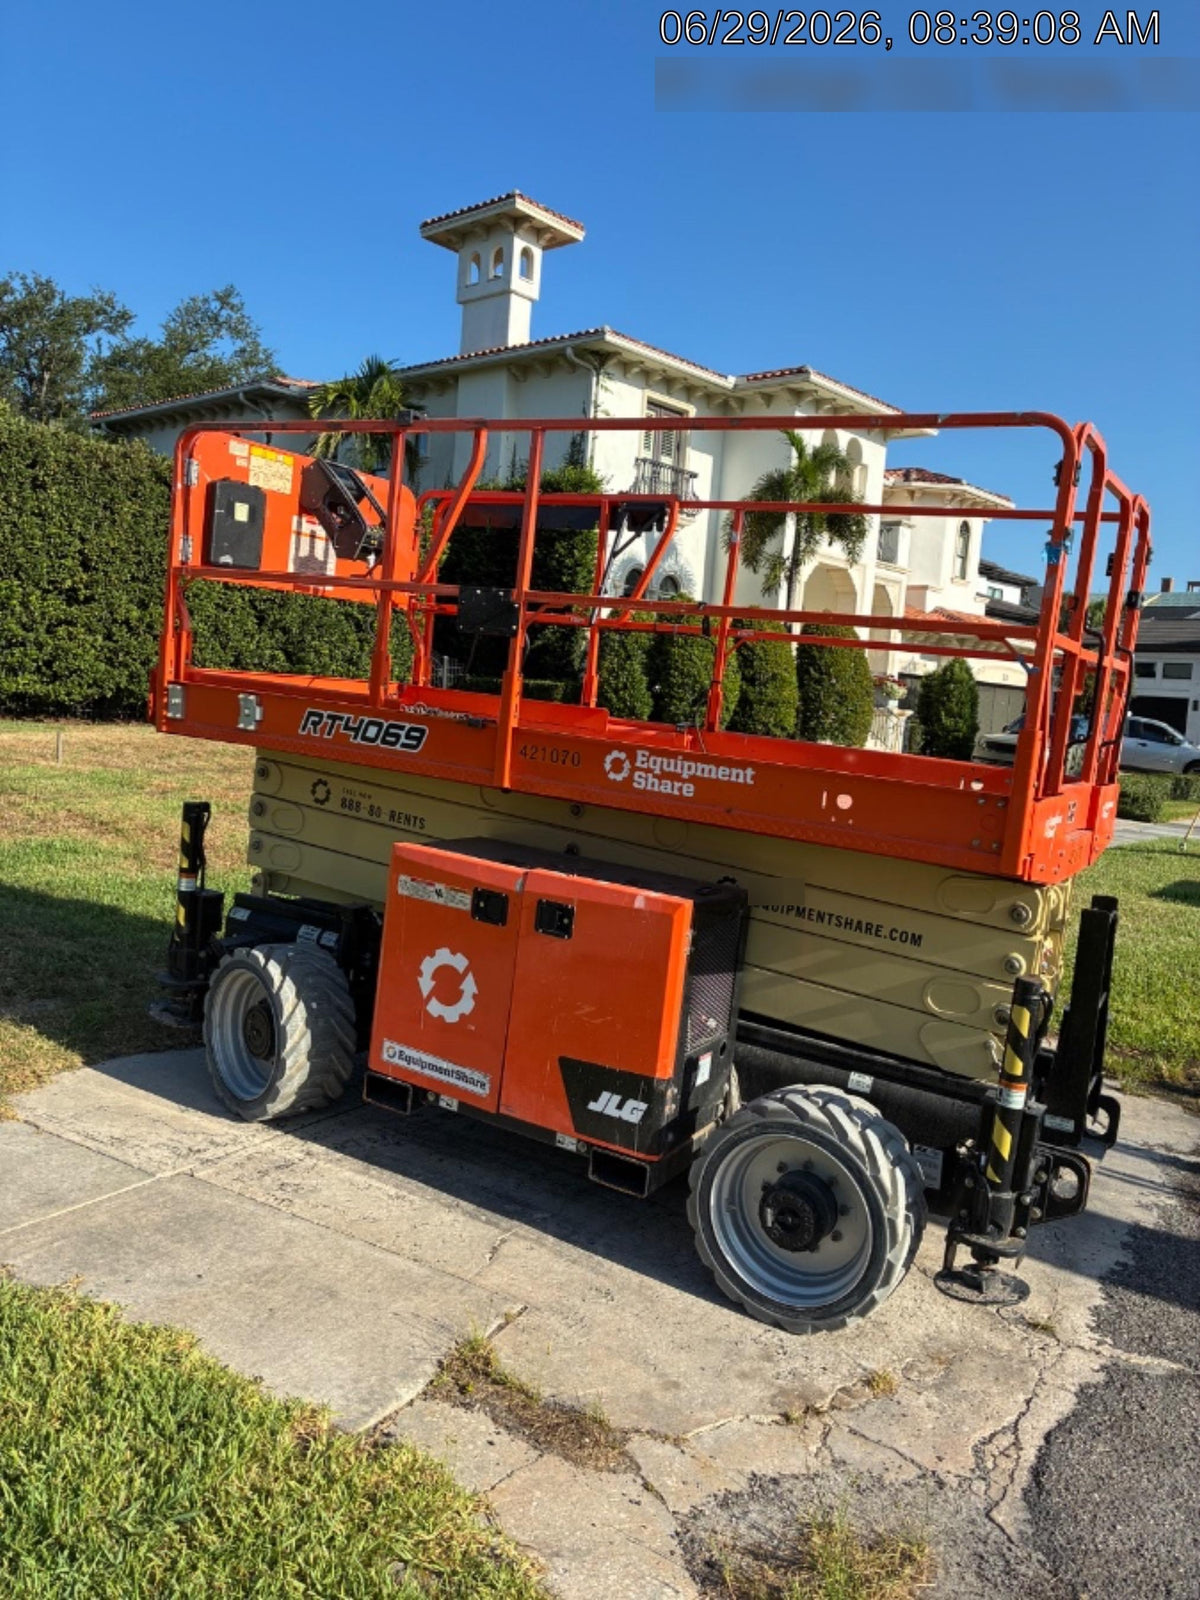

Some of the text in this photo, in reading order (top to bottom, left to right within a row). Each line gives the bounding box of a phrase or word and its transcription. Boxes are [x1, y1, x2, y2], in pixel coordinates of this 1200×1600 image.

[299, 708, 429, 752] RT4069
[519, 745, 581, 767] 421070
[635, 749, 755, 784] Equipment
[632, 771, 695, 798] Share
[754, 904, 923, 947] UIPMENTSHARE.COM
[398, 1049, 487, 1091] EquipmentShare
[587, 1091, 648, 1124] JLG
